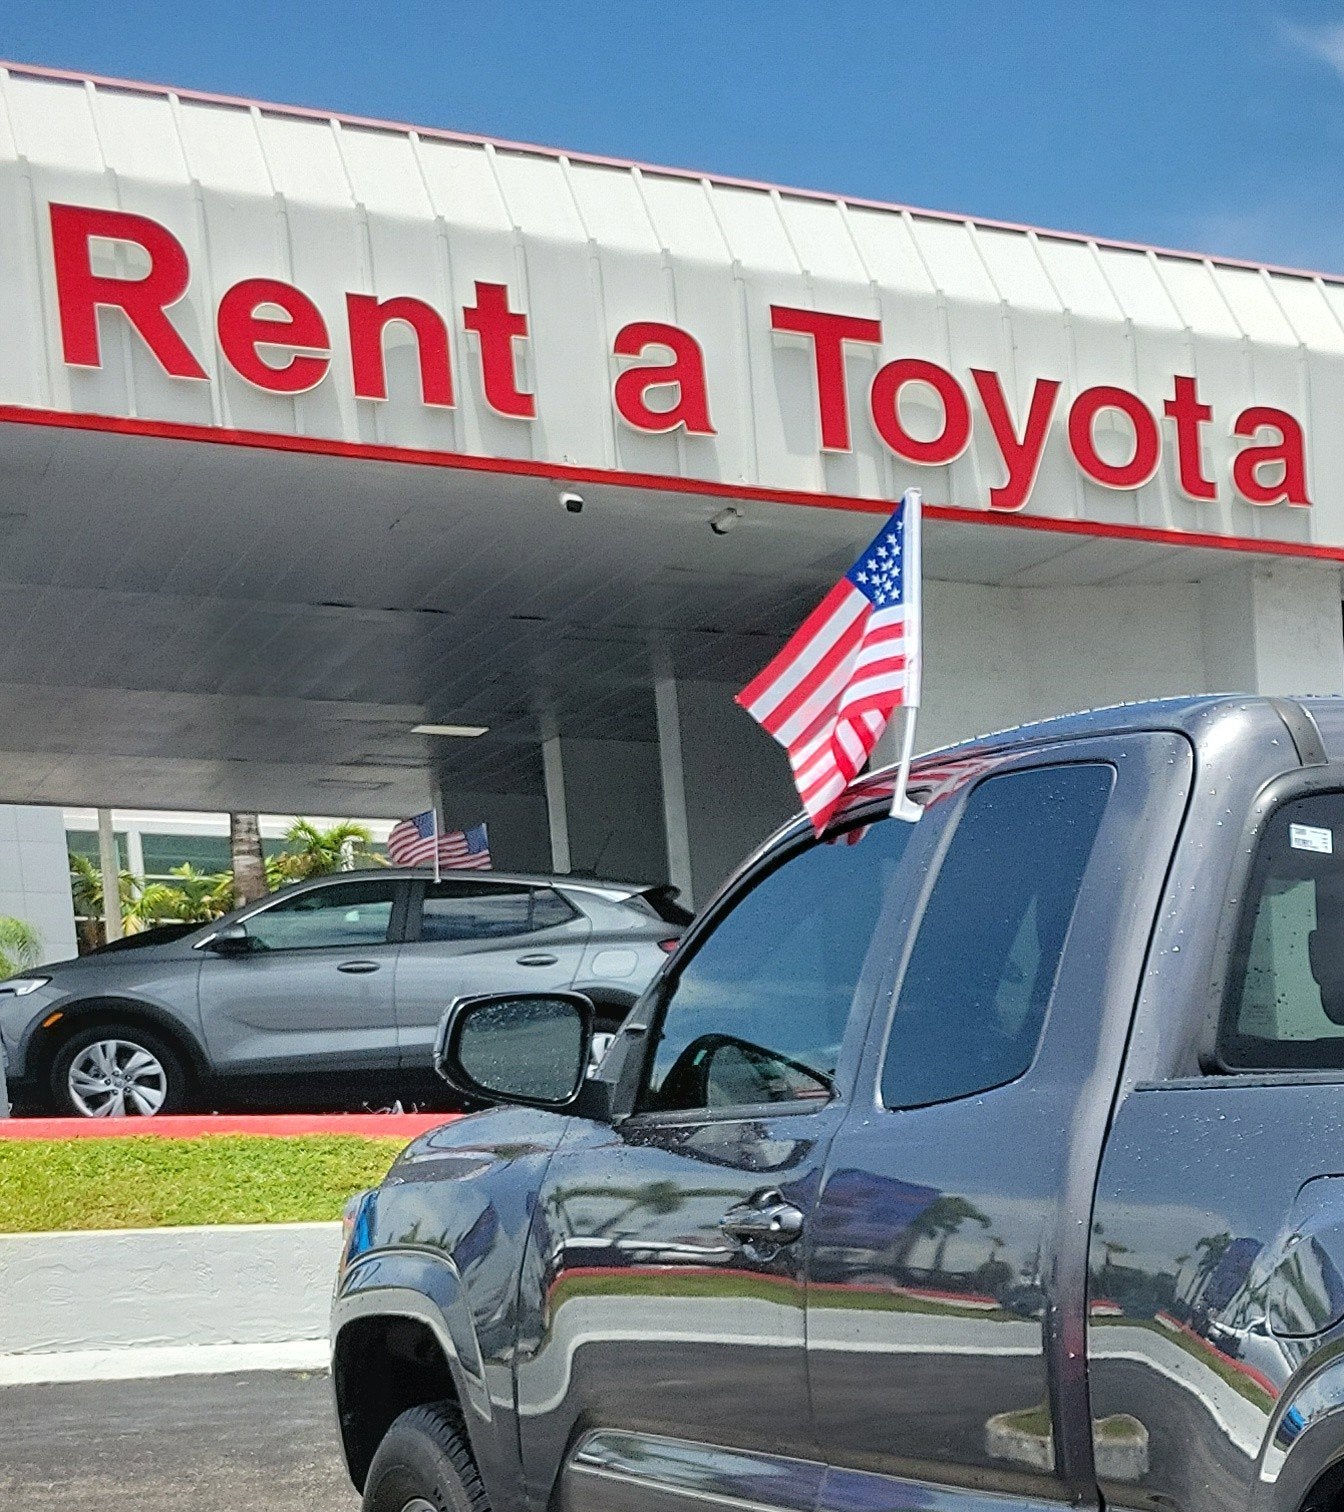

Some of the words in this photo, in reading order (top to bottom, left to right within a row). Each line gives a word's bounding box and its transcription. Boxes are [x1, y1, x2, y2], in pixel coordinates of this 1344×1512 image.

[49, 202, 534, 417] Rent
[613, 322, 716, 434] a
[770, 306, 1310, 510] Toyota
